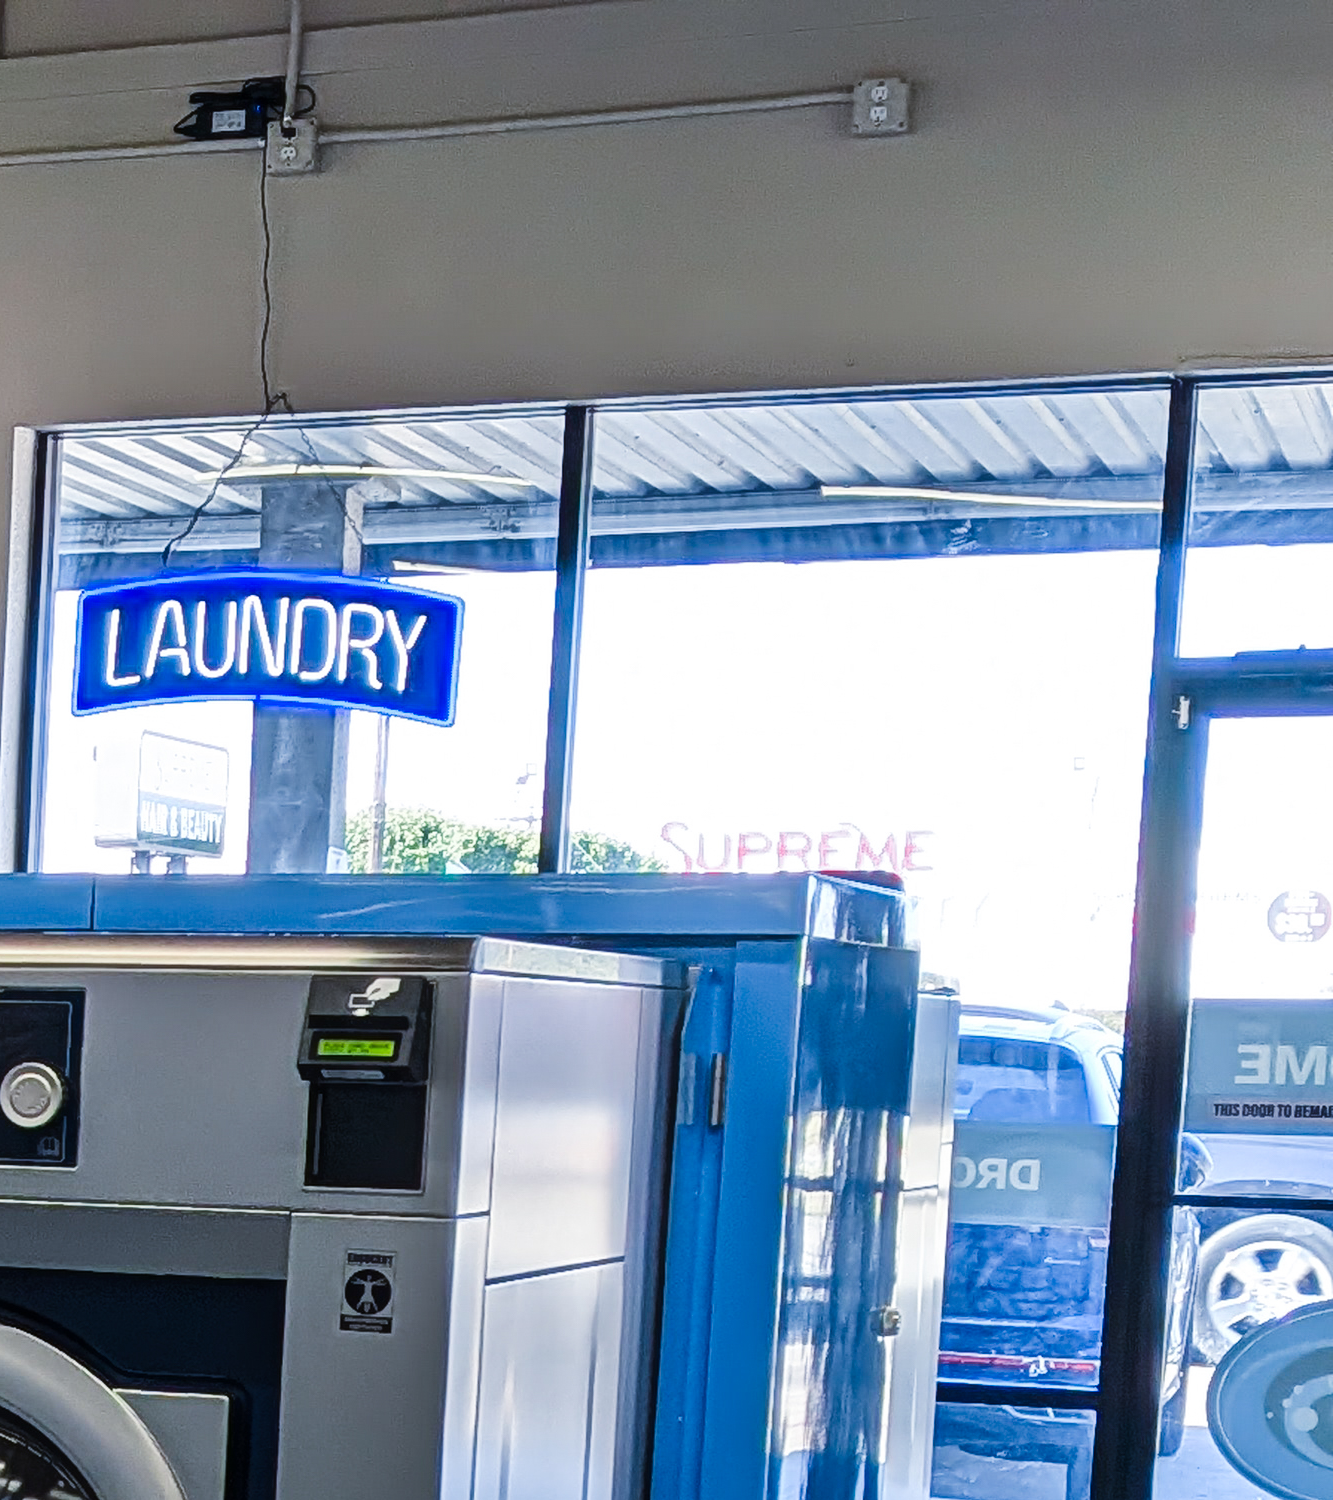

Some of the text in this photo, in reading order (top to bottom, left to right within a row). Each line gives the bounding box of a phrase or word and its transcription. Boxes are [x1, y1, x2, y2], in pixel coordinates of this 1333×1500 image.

[105, 594, 428, 693] LAUNDRY
[180, 807, 223, 844] BEAUTY
[660, 821, 935, 876] SUPREME
[1213, 1103, 1240, 1117] THIS
[1242, 1103, 1275, 1118] DOOR
[1277, 1104, 1292, 1118] TO
